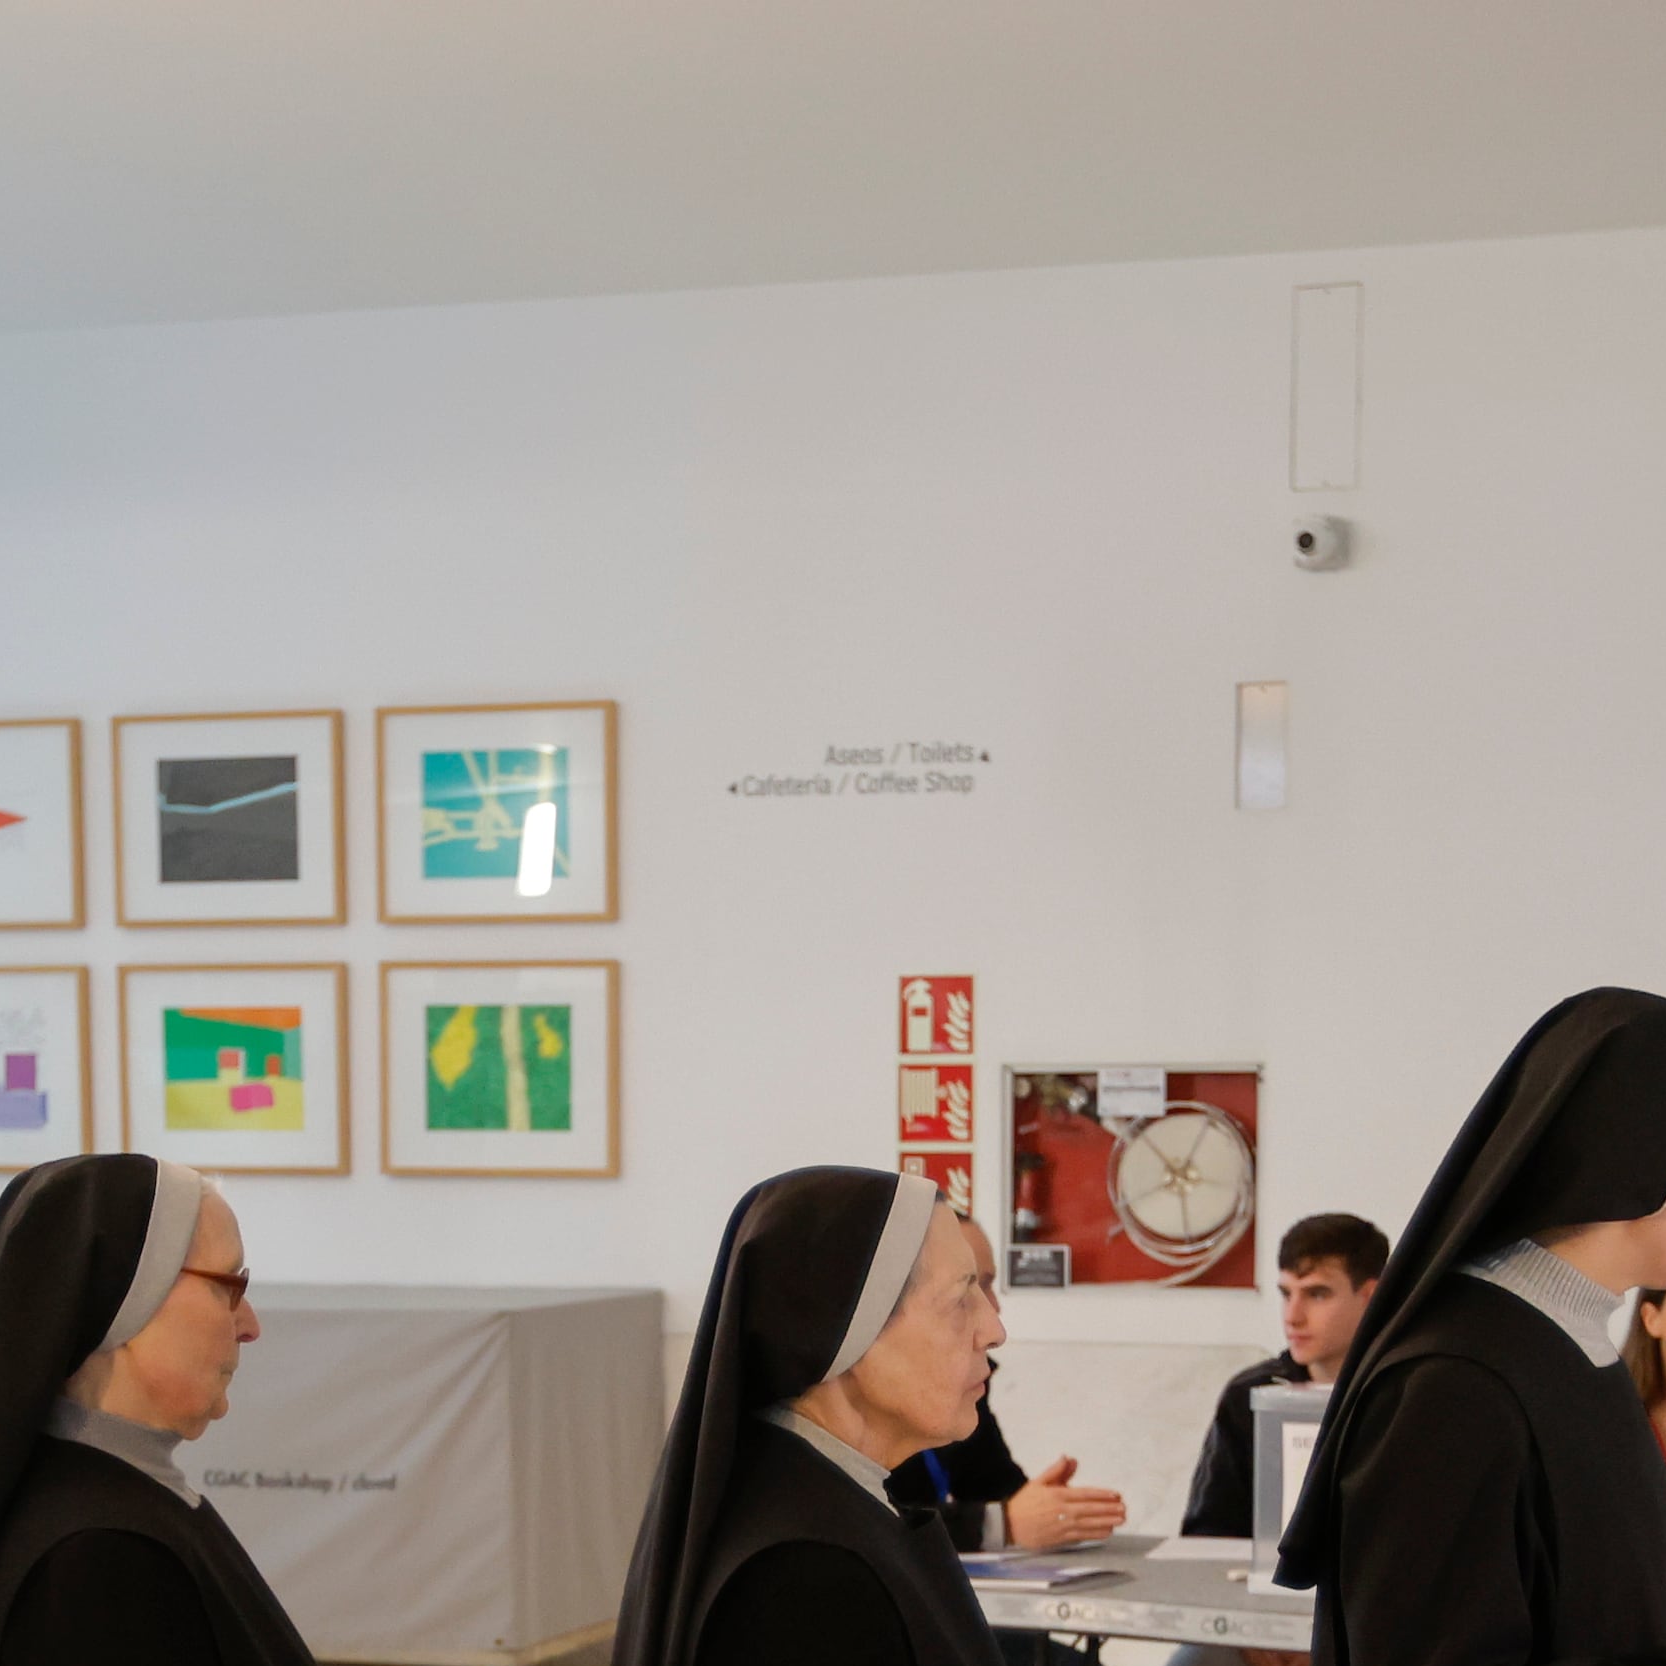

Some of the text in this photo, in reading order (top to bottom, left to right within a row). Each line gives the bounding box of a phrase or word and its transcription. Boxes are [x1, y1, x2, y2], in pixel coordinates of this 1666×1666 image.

[825, 742, 974, 766] Aseos / Toilets
[836, 773, 850, 795] /
[854, 770, 918, 794] Coffee
[924, 770, 973, 793] Shop
[204, 1470, 250, 1487] CGAC
